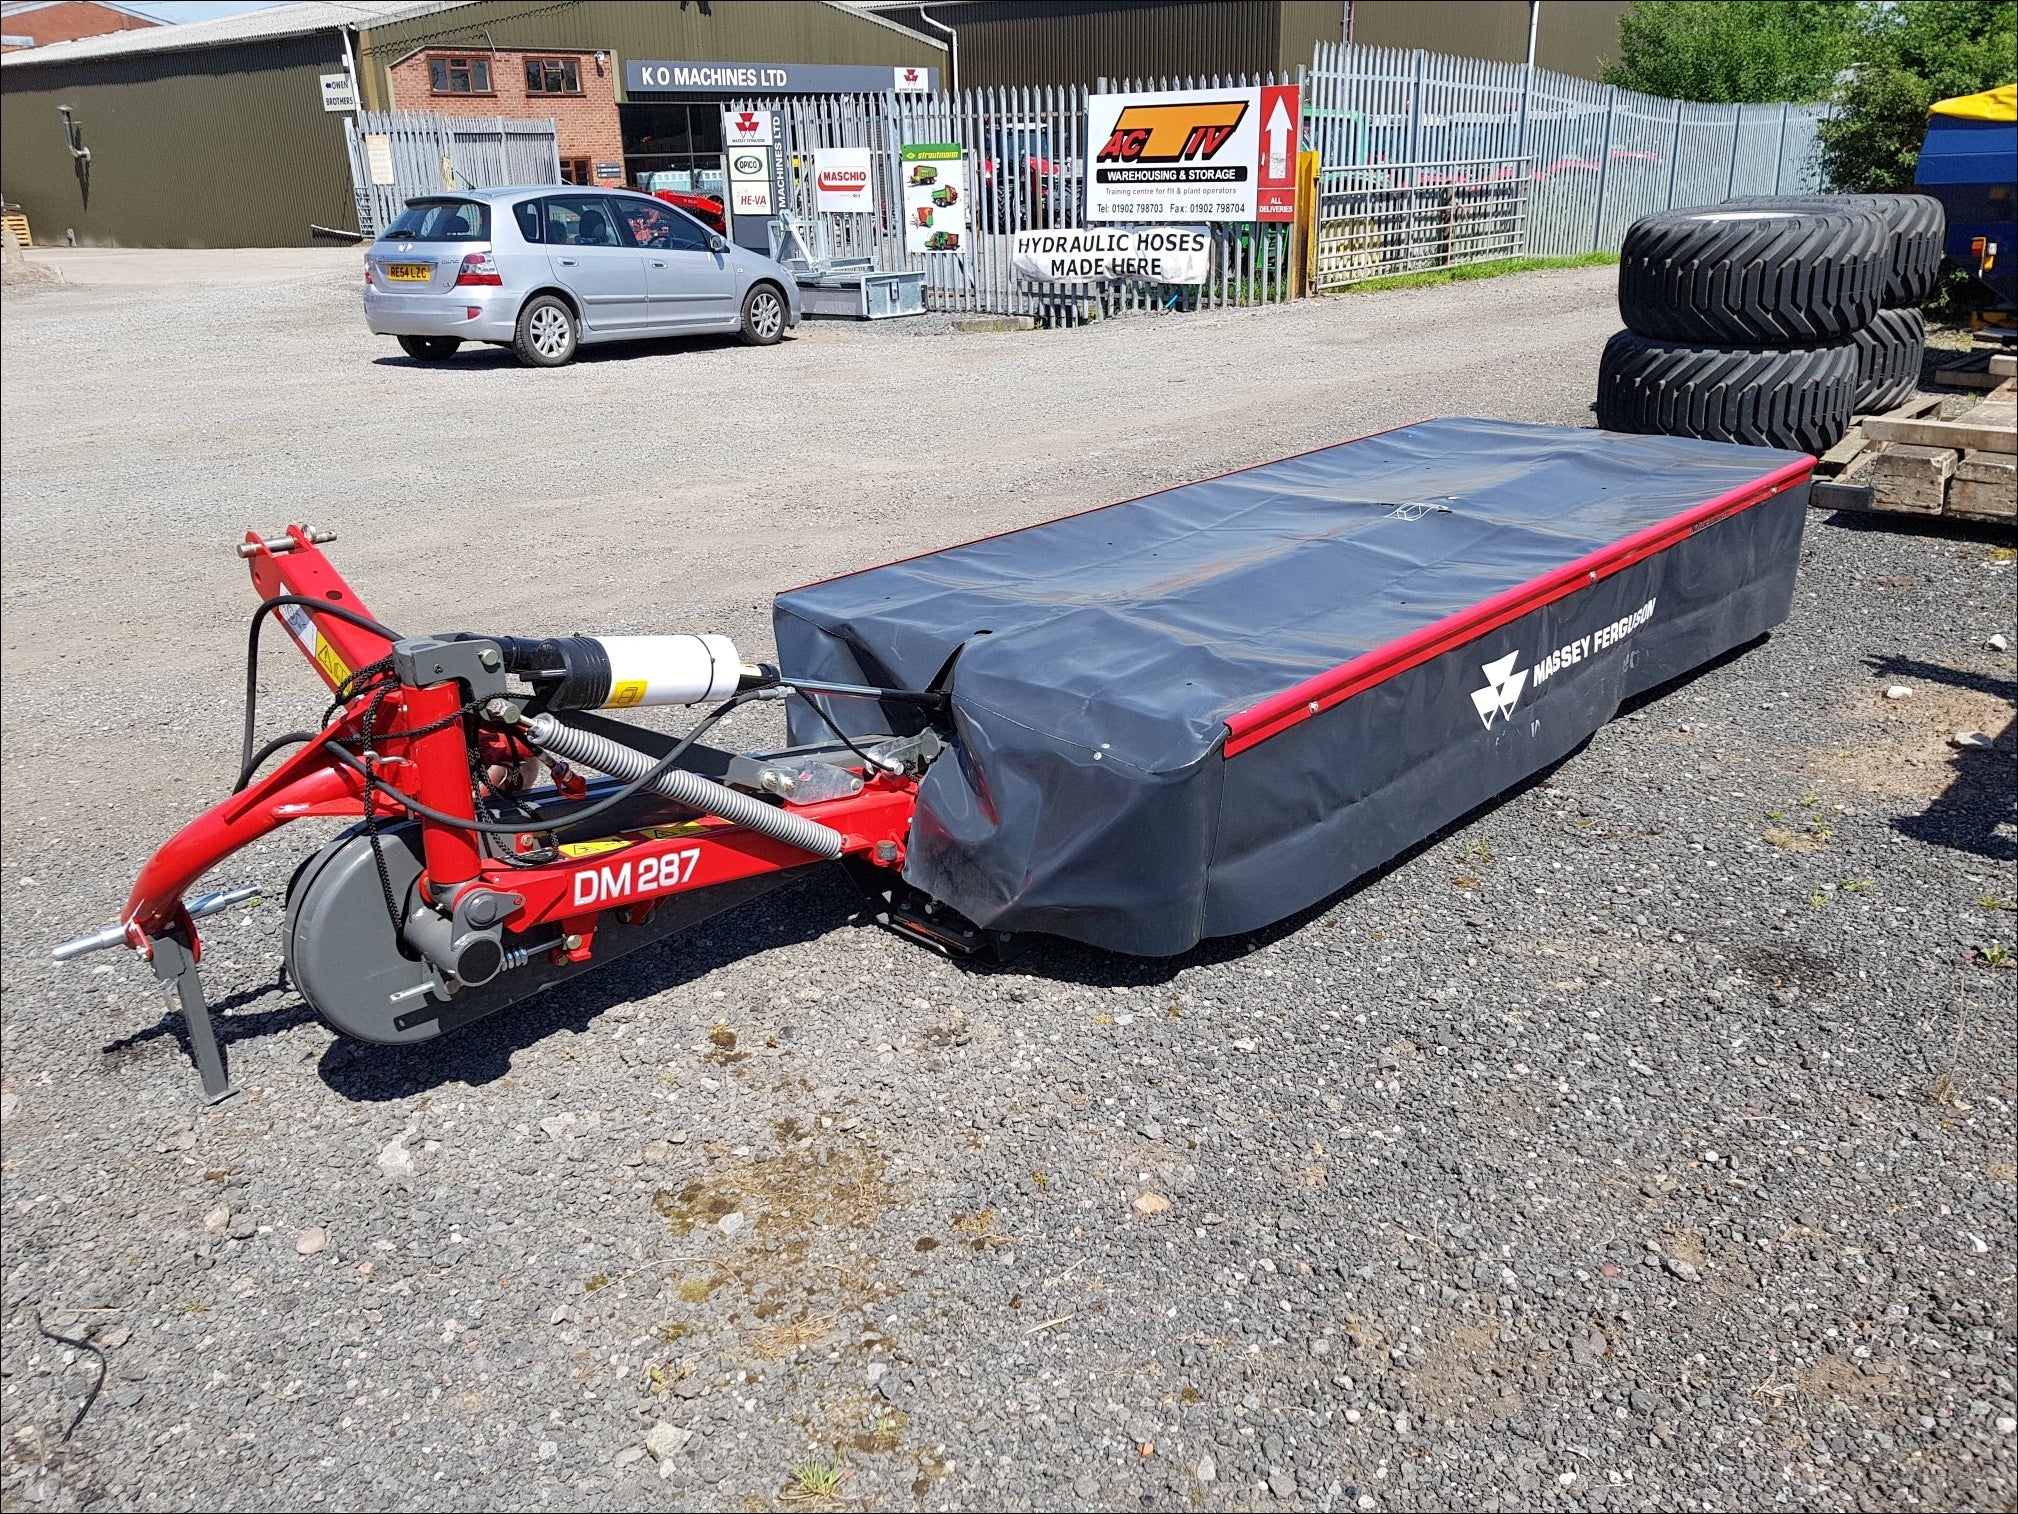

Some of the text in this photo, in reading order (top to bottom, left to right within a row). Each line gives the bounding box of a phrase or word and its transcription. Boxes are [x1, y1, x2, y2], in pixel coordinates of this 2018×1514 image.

[641, 67, 788, 87] K O MACHINES LTD
[331, 81, 349, 89] OWEN
[325, 97, 353, 106] BROTHERS
[739, 160, 757, 169] OPICO
[772, 116, 786, 208] MACHINES LTD
[823, 171, 867, 181] MASCHIO
[1107, 168, 1236, 181] WAREHOUSING & STORAGE
[1106, 188, 1131, 196] Training
[1176, 187, 1181, 195] &
[1183, 187, 1201, 197] plant
[1202, 187, 1237, 196] operators
[1270, 197, 1282, 205] ALL
[1097, 203, 1245, 213] Tel: 01902 798703 Fax: 01902 798704
[1259, 205, 1293, 213] DELIVERIES
[1018, 233, 1205, 254] HYDRAULIC HOSES
[390, 266, 427, 279] RE54 LZC
[1051, 258, 1162, 276] MADE HERE
[1532, 597, 1657, 687] MASSEY FERGUSON
[573, 847, 701, 907] DM 287
